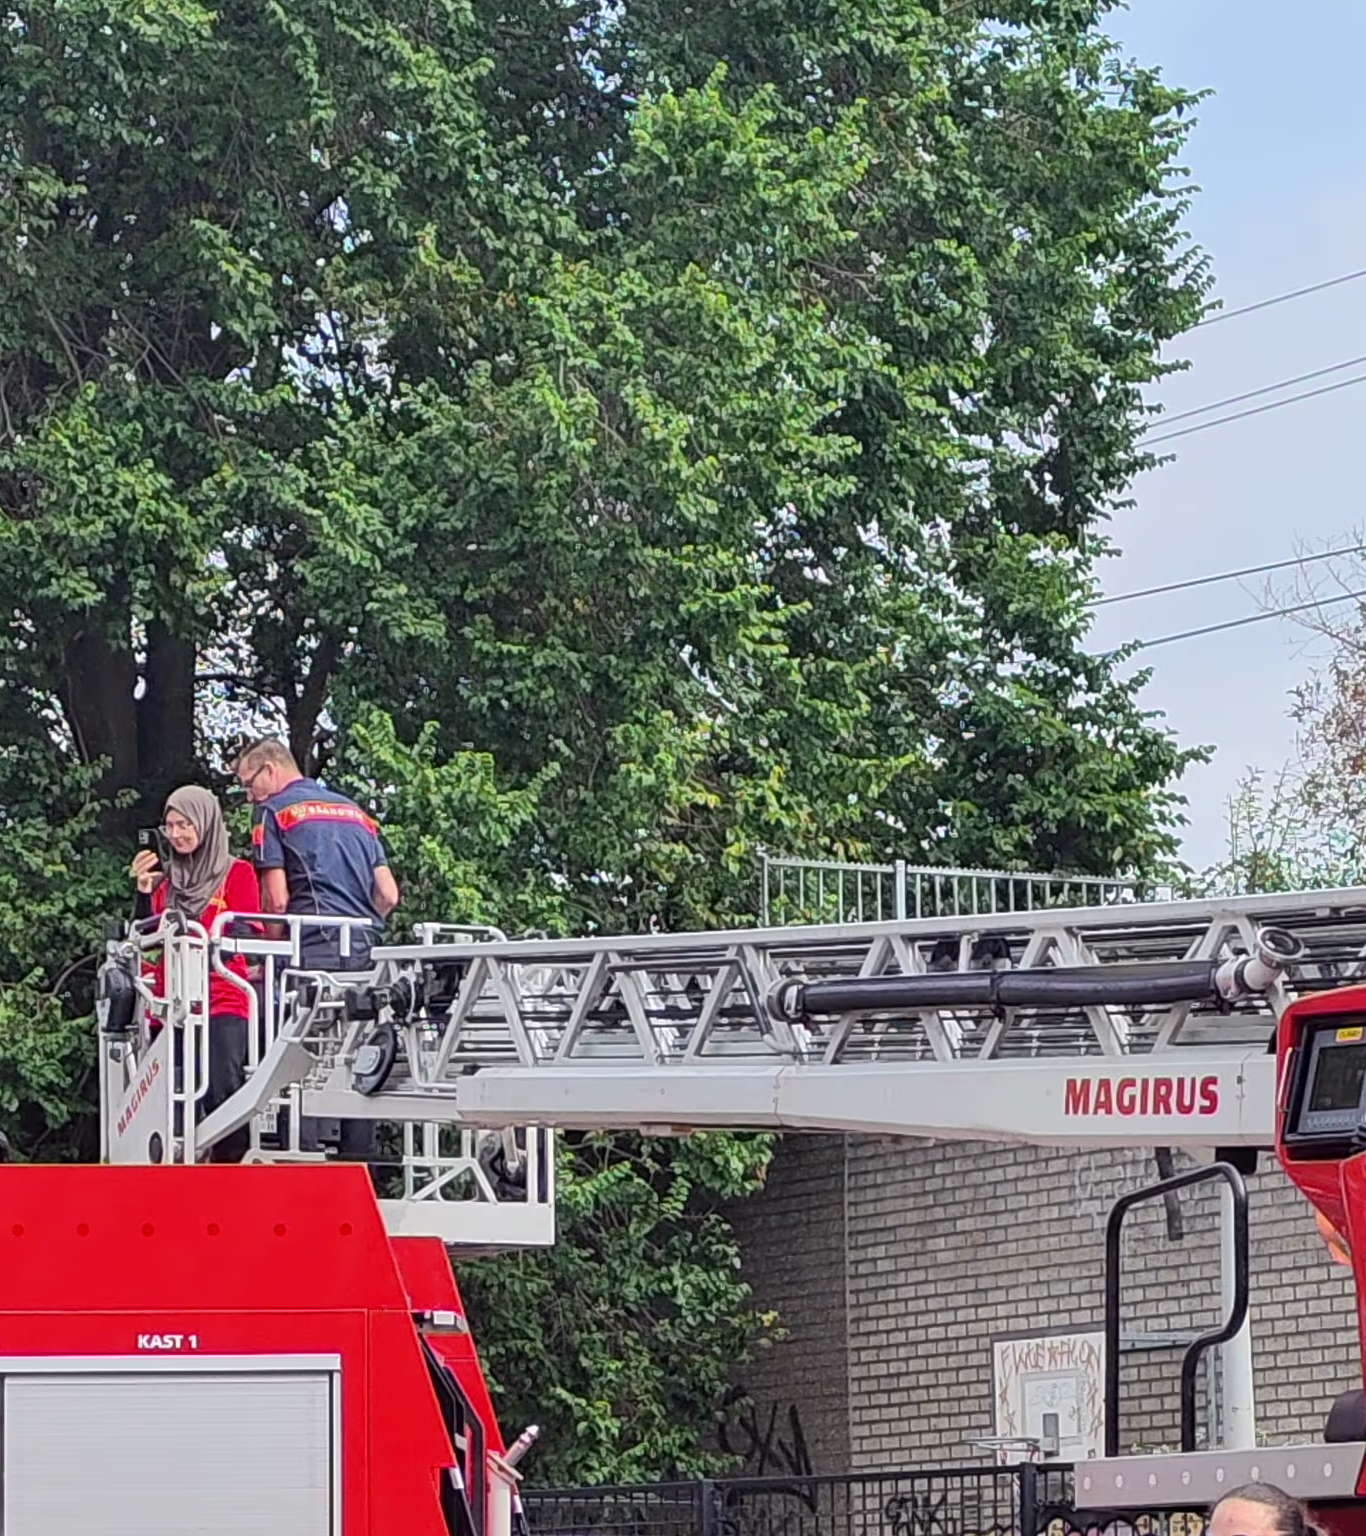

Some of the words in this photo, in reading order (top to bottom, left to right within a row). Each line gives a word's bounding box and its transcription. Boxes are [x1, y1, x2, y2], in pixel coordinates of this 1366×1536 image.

[117, 1057, 161, 1138] MAGIRUS
[1064, 1075, 1219, 1116] MAGIRUS
[137, 1333, 184, 1349] KAST
[188, 1333, 198, 1349] 1
